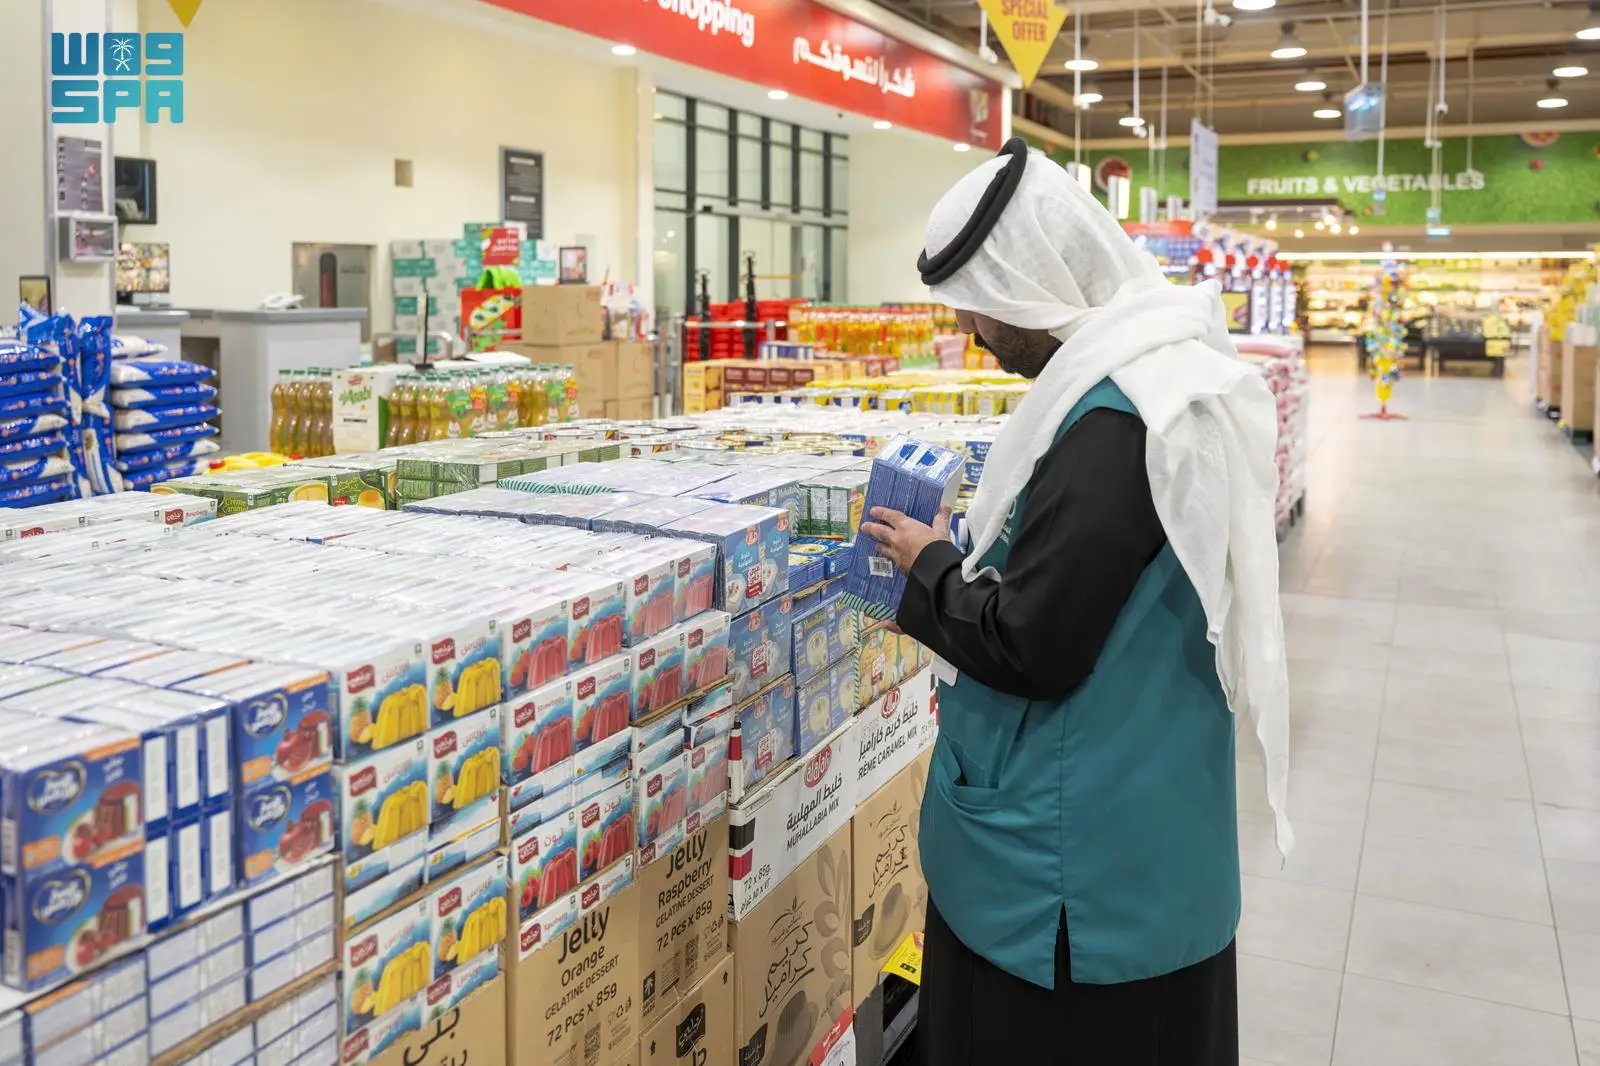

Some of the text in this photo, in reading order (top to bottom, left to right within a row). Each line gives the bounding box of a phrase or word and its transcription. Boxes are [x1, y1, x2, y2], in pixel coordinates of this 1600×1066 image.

[1012, 20, 1046, 42] OFFER
[1247, 177, 1319, 195] FRUITS
[1323, 176, 1339, 194] &
[877, 735, 906, 765] CARAMEL
[907, 724, 918, 739] MIX
[786, 796, 840, 852] MUHALLABIA MIX
[665, 830, 707, 879] Jelly
[655, 874, 714, 929] GELATINE DESSERT
[658, 858, 712, 910] Raspberry
[558, 906, 610, 964] Jelly
[657, 932, 669, 952] 72
[545, 954, 620, 1021] GELATINE DESSERT
[561, 945, 605, 988] Orange
[547, 1023, 562, 1047] 72
